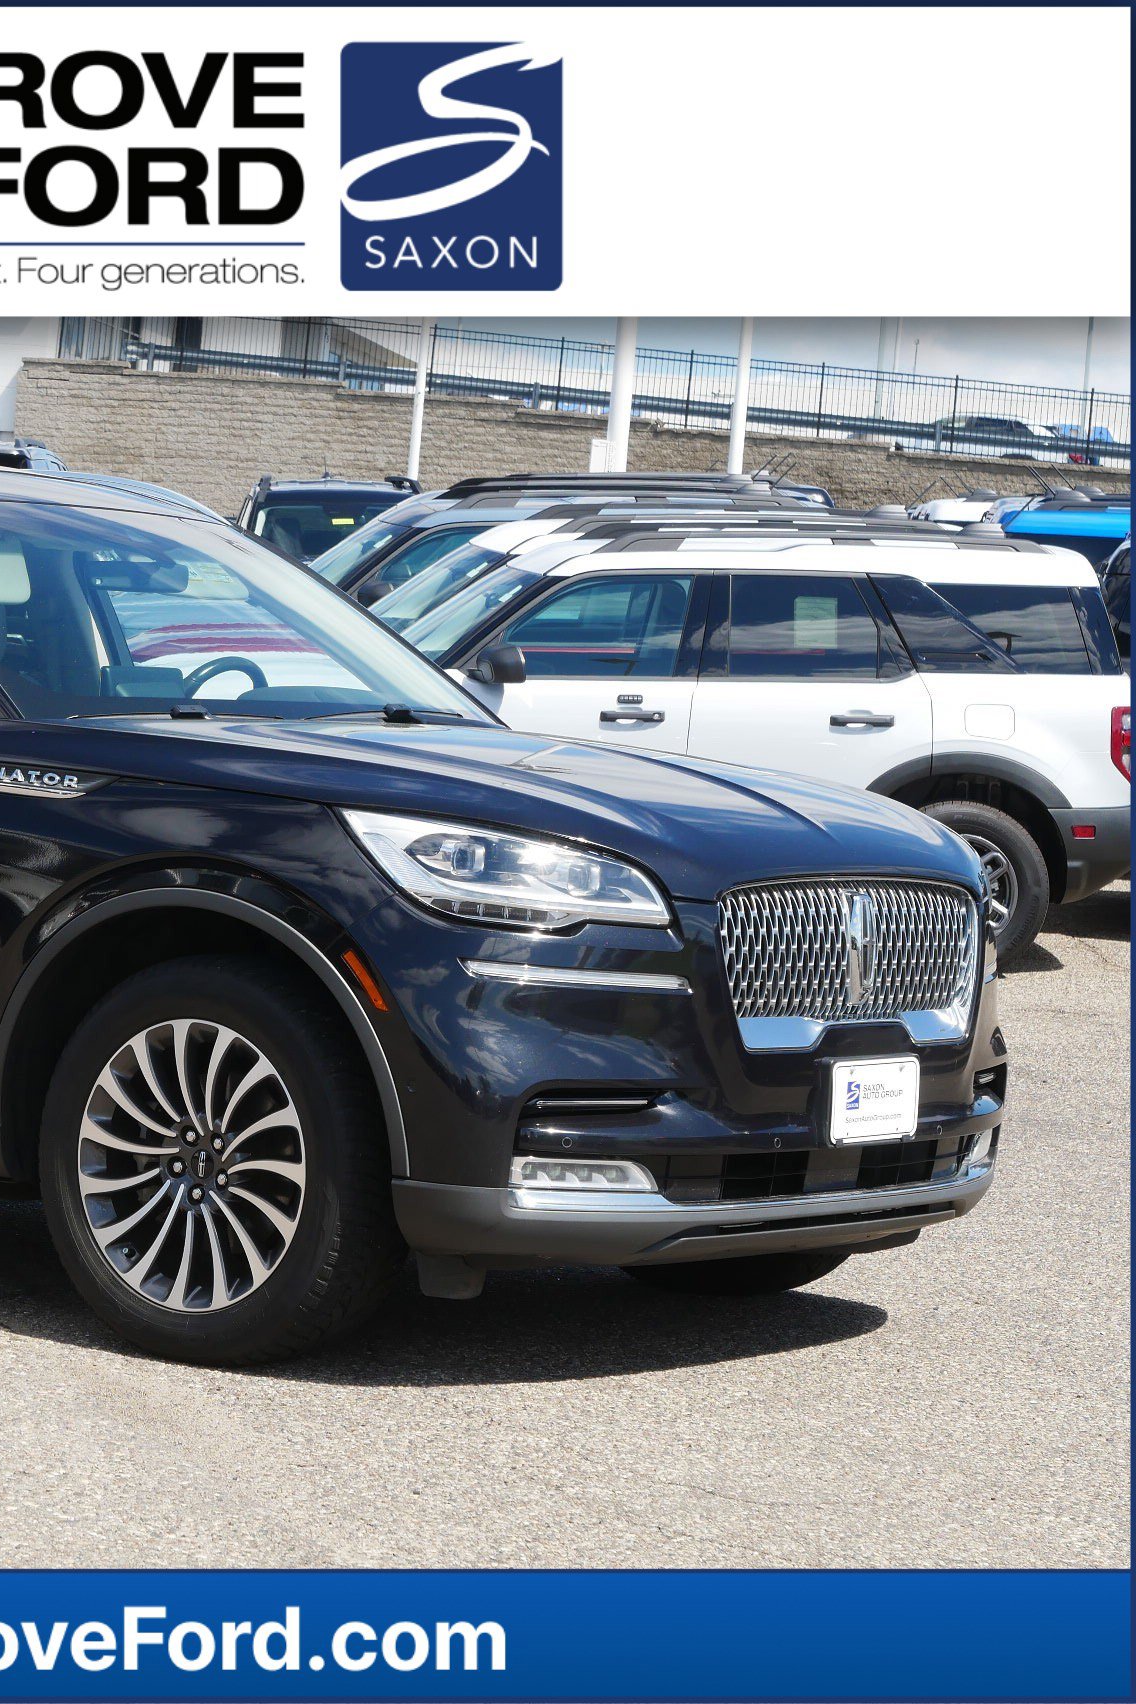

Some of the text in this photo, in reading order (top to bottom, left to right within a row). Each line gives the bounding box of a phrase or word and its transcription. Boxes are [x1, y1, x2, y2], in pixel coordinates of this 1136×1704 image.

[863, 1083, 885, 1092] SAXON
[863, 1090, 903, 1099] AUTO GROUP
